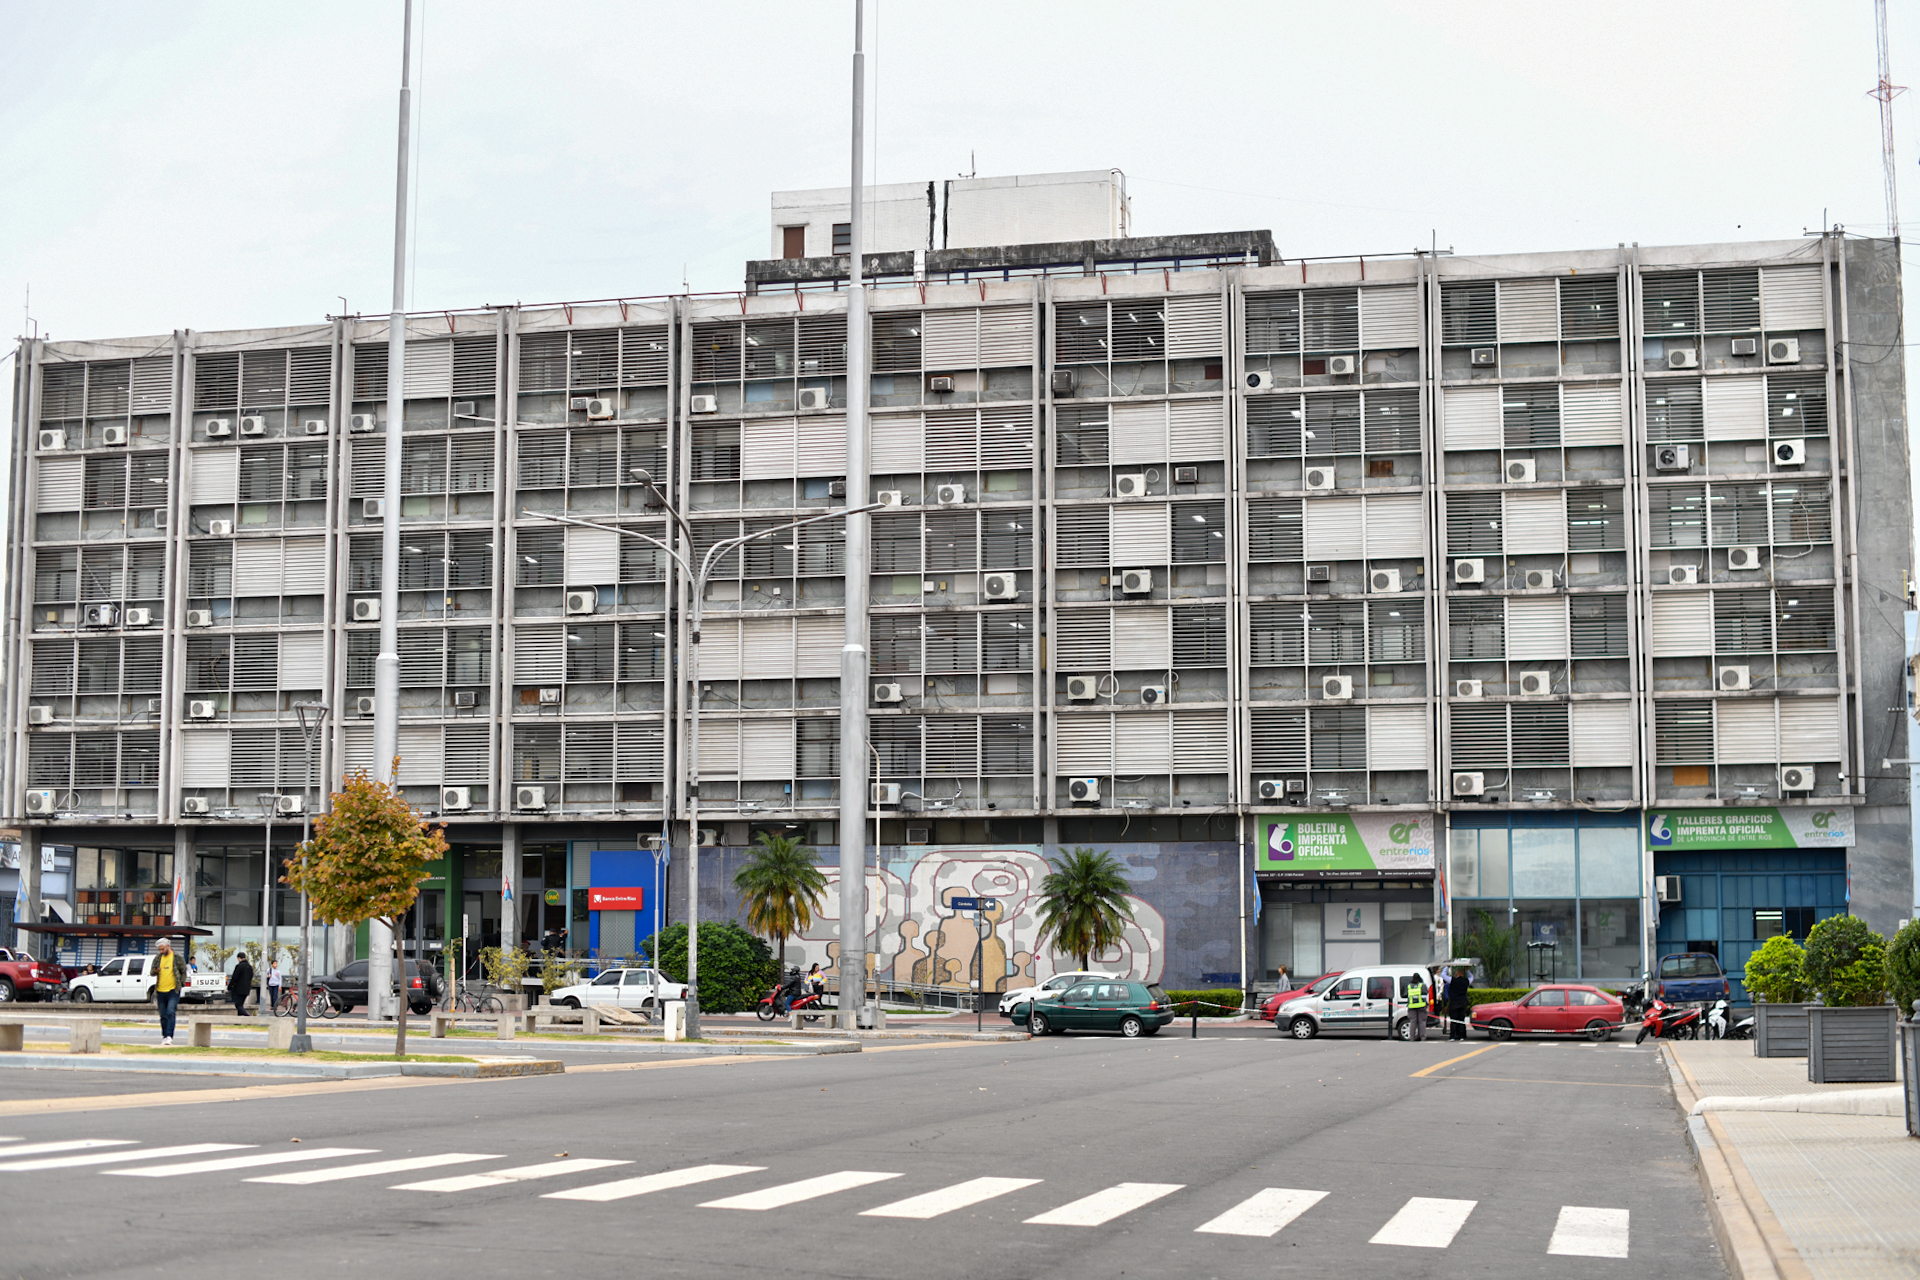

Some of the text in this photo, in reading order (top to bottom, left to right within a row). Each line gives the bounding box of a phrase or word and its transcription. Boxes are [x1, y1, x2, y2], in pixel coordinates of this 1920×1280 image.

[1676, 814, 1773, 826] TALLERES GRAFICOS
[1297, 822, 1346, 834] BOLETIN e
[1676, 824, 1766, 836] IMPRENTA OFICIAL
[1297, 834, 1348, 846] IMPRENTA
[1686, 835, 1694, 843] LA
[1695, 834, 1727, 843] PROVINCIA
[1727, 834, 1736, 842] DE
[1737, 834, 1756, 842] ENTRE
[1297, 845, 1335, 857] OFICIAL
